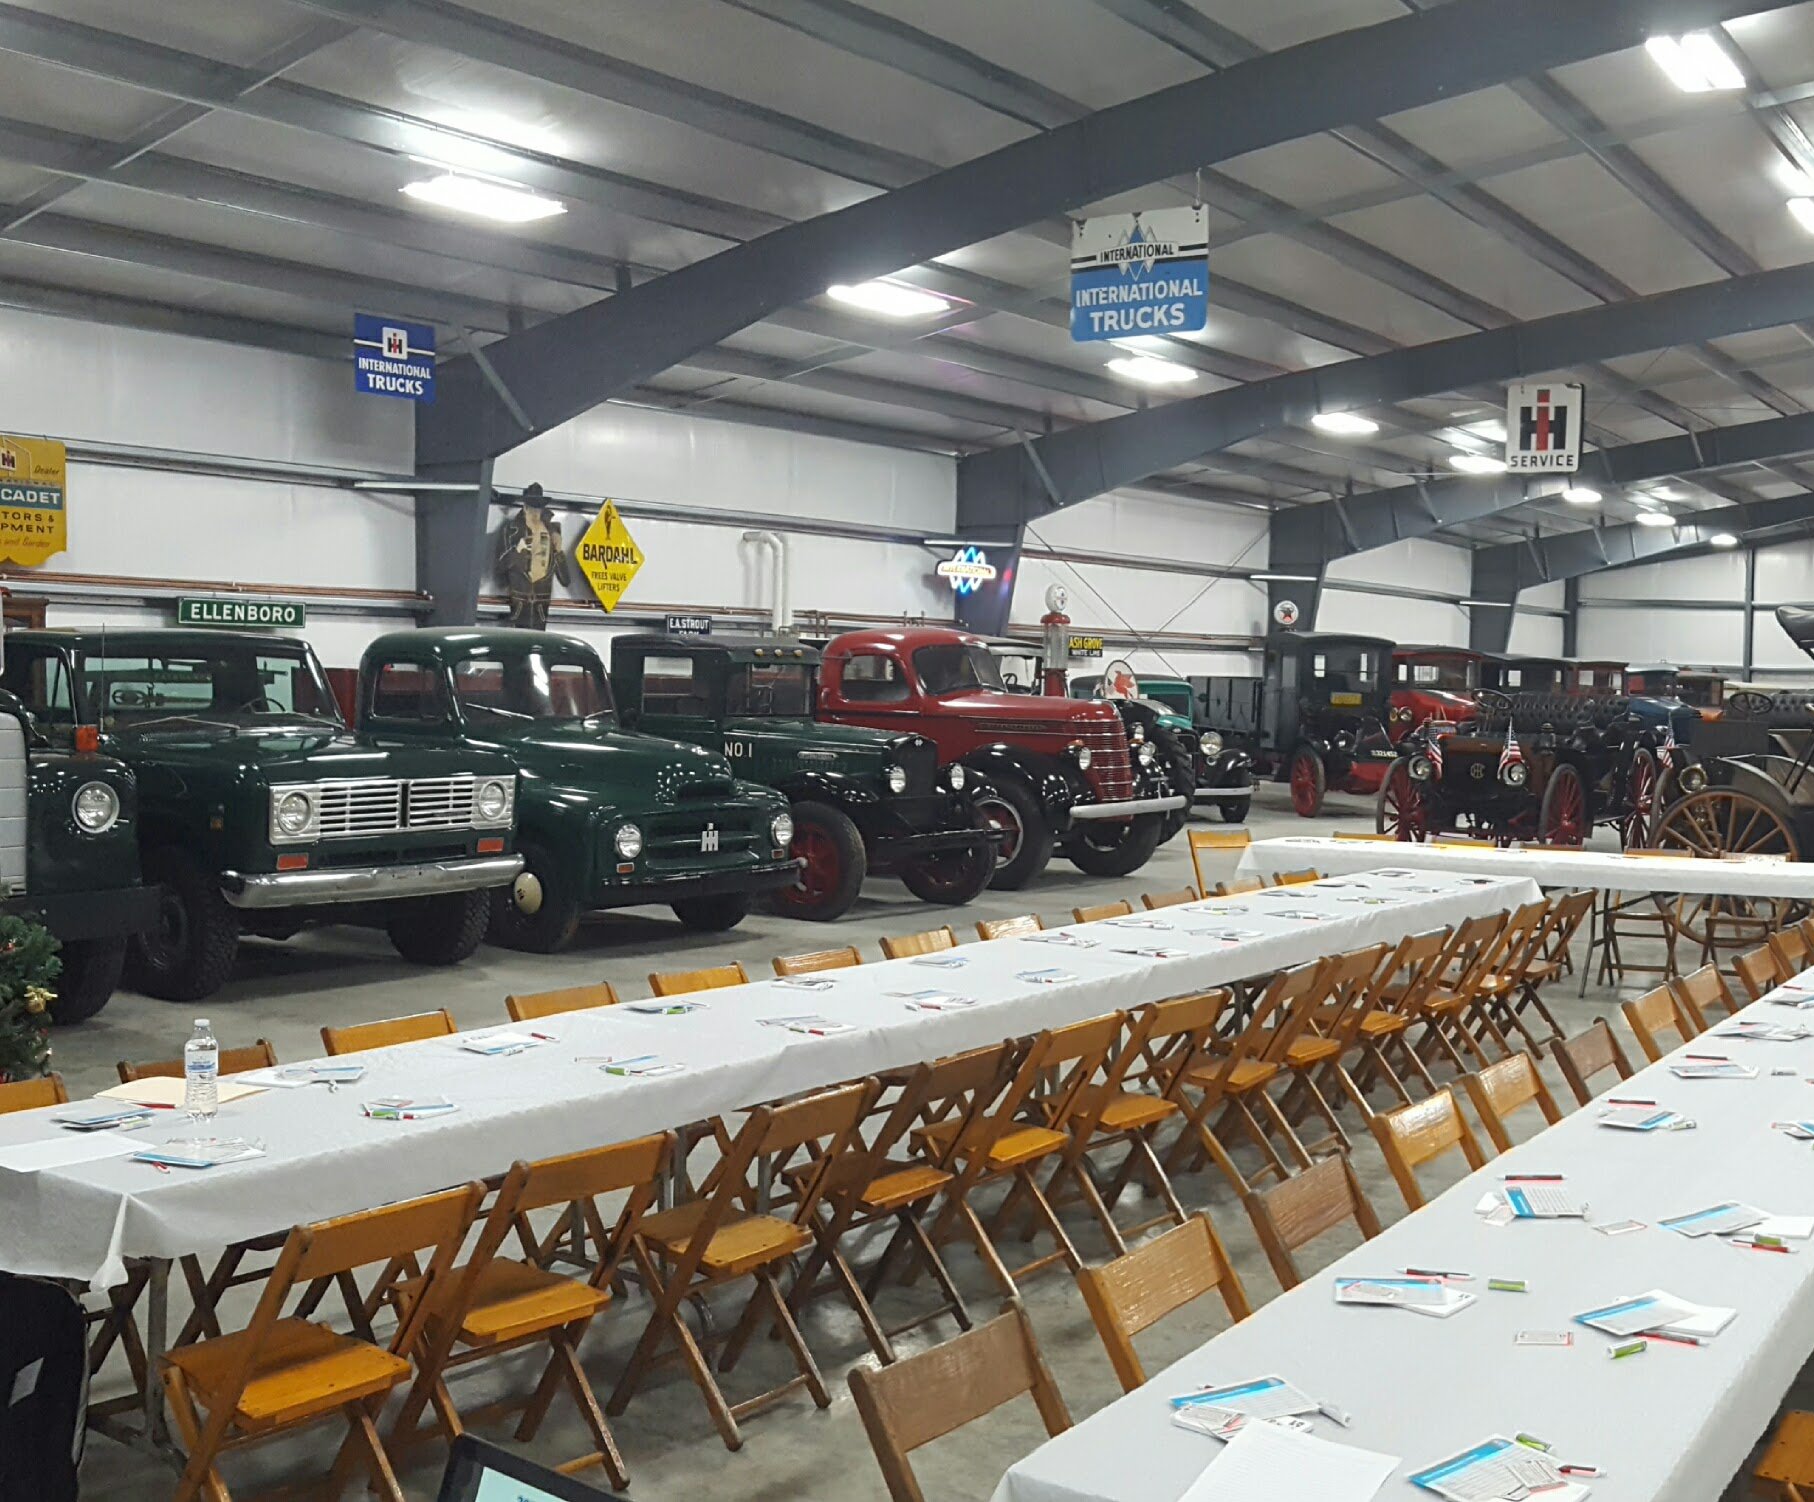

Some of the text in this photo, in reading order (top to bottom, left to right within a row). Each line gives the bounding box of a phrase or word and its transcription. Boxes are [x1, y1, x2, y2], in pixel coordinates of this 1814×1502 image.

[1100, 242, 1174, 262] INTERNATIONAL
[1075, 278, 1204, 308] INTERNATIONAL
[1089, 302, 1186, 333] TRUCKS
[358, 356, 432, 380] INTERNATIONAL
[366, 373, 424, 396] TRUCKS
[33, 464, 60, 476] Dealer
[1510, 454, 1575, 468] SERVICE
[0, 487, 61, 504] CADET
[47, 514, 54, 523] &
[582, 543, 638, 570] BARDAHL
[591, 571, 627, 581] FREES VALVE
[597, 582, 620, 592] LIFTERS
[191, 603, 296, 623] ELLENBORO
[1068, 636, 1103, 650] ASH GROVE
